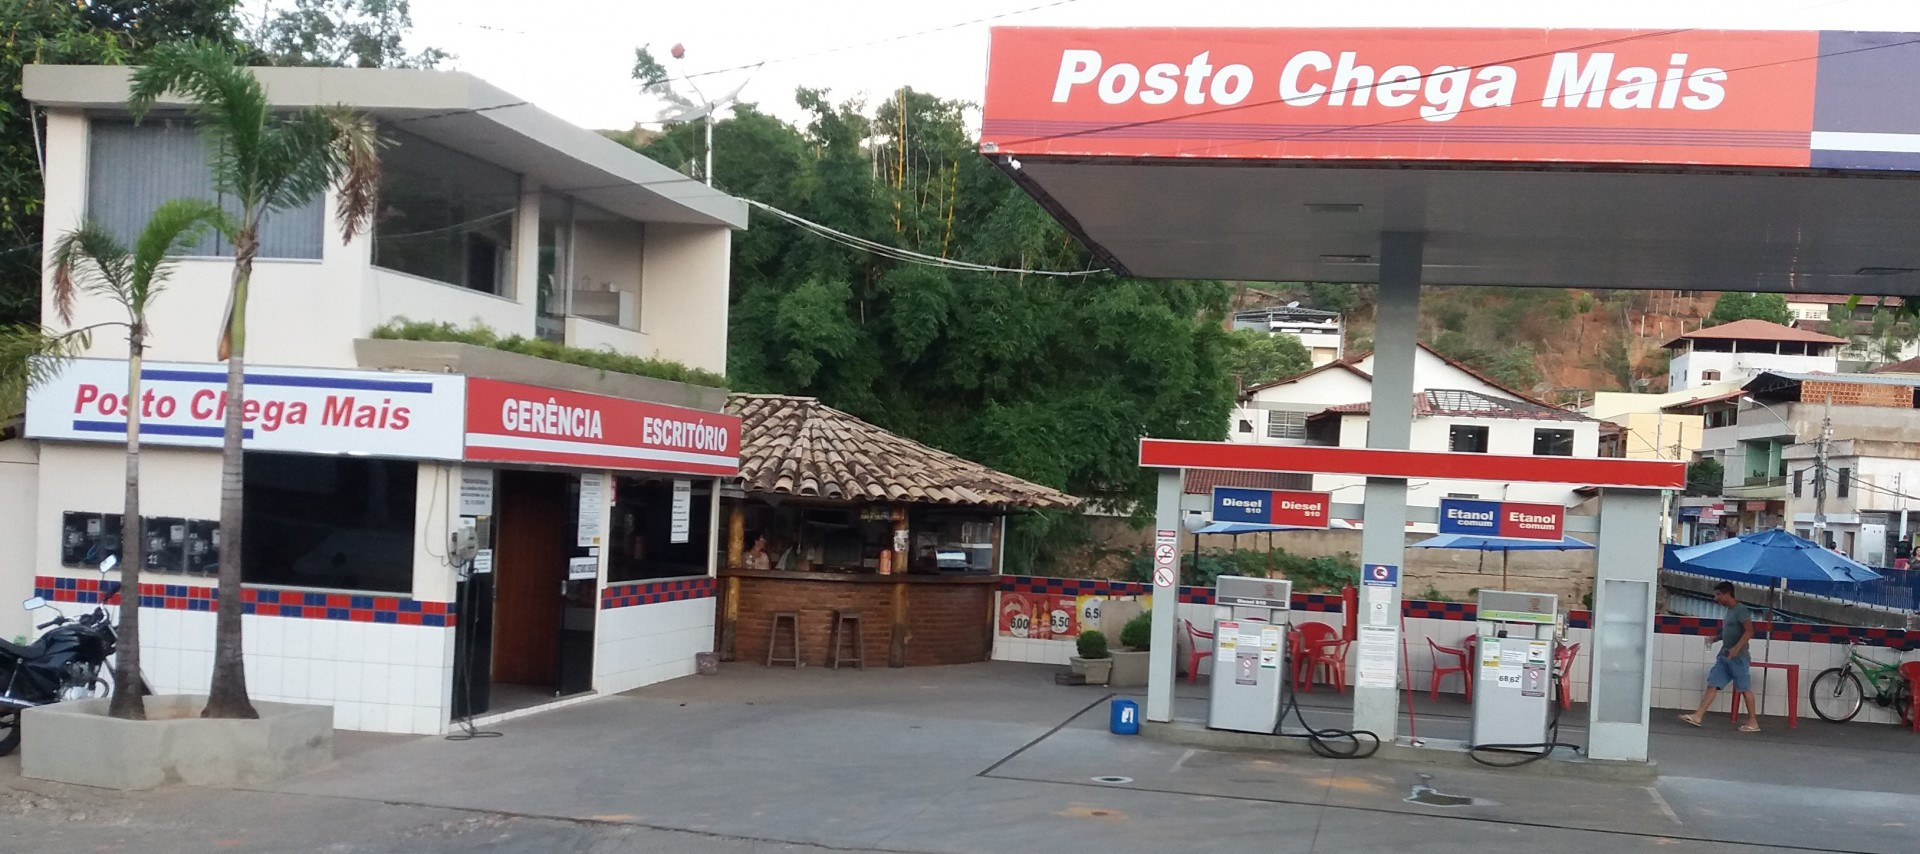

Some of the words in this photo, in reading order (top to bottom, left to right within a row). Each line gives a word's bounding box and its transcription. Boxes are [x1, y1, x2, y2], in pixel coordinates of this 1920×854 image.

[1052, 50, 1253, 106] Posto
[1279, 51, 1516, 122] Chega
[1542, 52, 1727, 110] Mais
[74, 384, 176, 418] Posto
[191, 389, 307, 431] Chega
[321, 396, 411, 430] Mais
[502, 397, 602, 438] GERÊNCIA
[642, 416, 728, 452] ESCRITÓRIO
[1222, 497, 1262, 508] Diesel
[1281, 500, 1321, 511] Diesel
[1447, 508, 1494, 521] Etanol
[1509, 511, 1556, 524] Etanol
[1457, 519, 1493, 527] comum
[1519, 522, 1555, 531] comum
